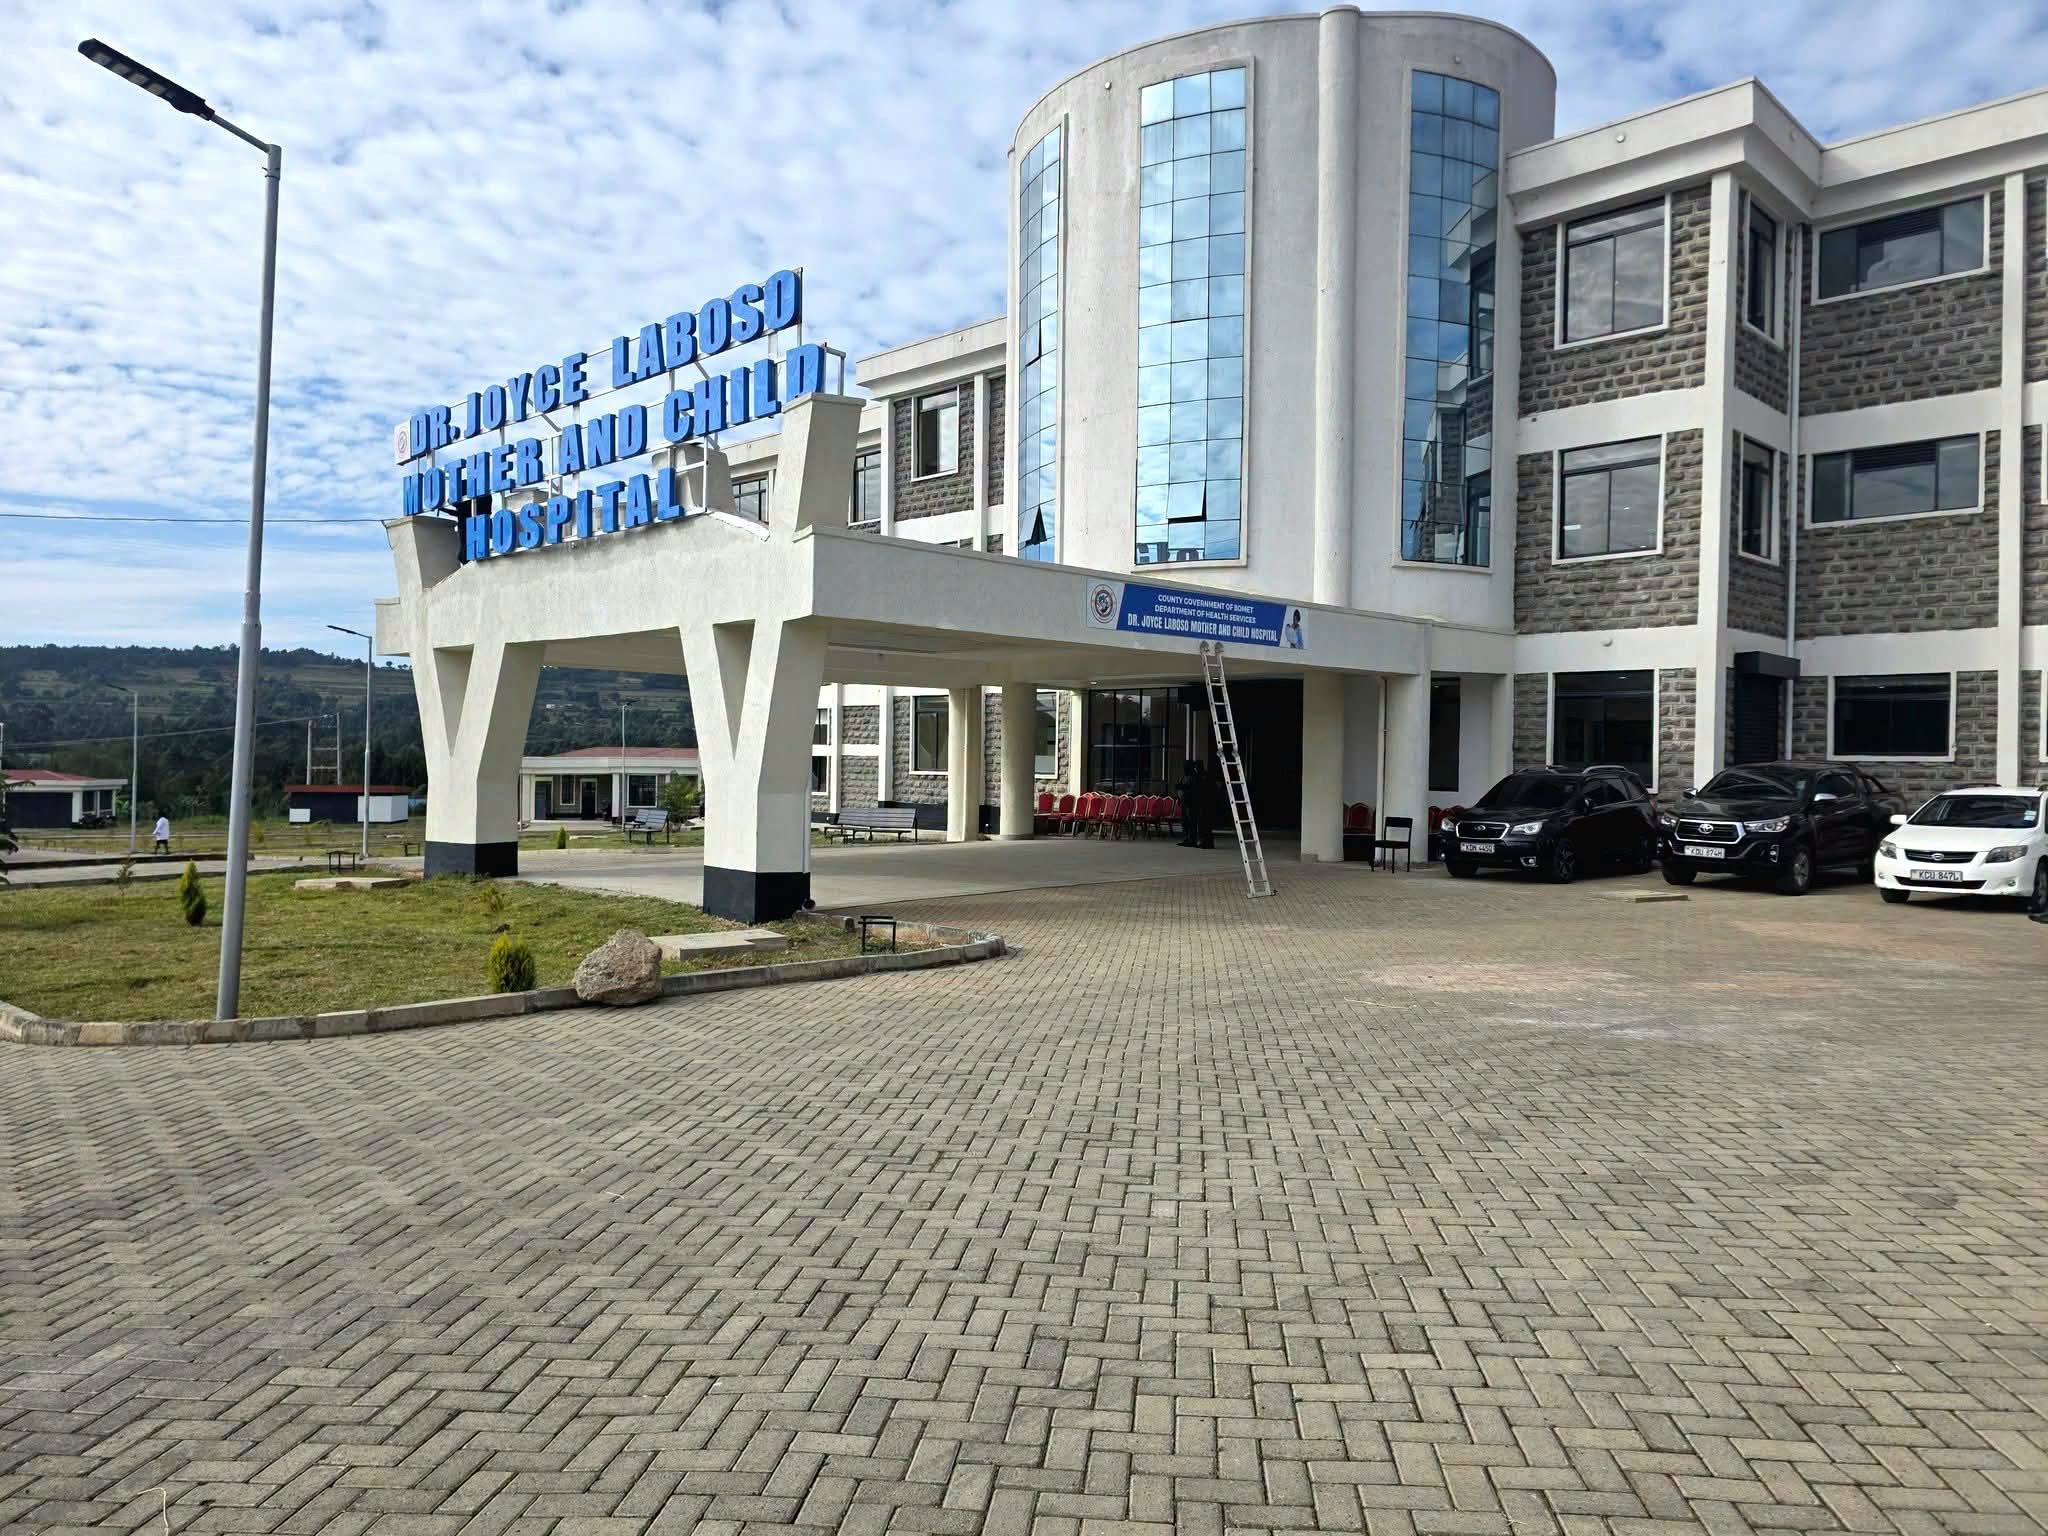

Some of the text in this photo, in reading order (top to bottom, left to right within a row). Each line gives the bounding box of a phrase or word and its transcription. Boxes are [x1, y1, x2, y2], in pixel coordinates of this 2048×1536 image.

[611, 269, 801, 389] LABOSO
[402, 343, 825, 516] MOTHER AND CHILD
[465, 467, 684, 561] HOSPITAL
[1154, 604, 1257, 624] DEPARTMENT OF HEALTH SERVICES
[1157, 594, 1254, 614] COUNTY GOVERNMENT OF BOMET
[1127, 613, 1278, 642] DR. JOYCE LABOSO MOTHER AND CHILD HOSPITAL
[1919, 871, 1960, 881] KCU 847L
